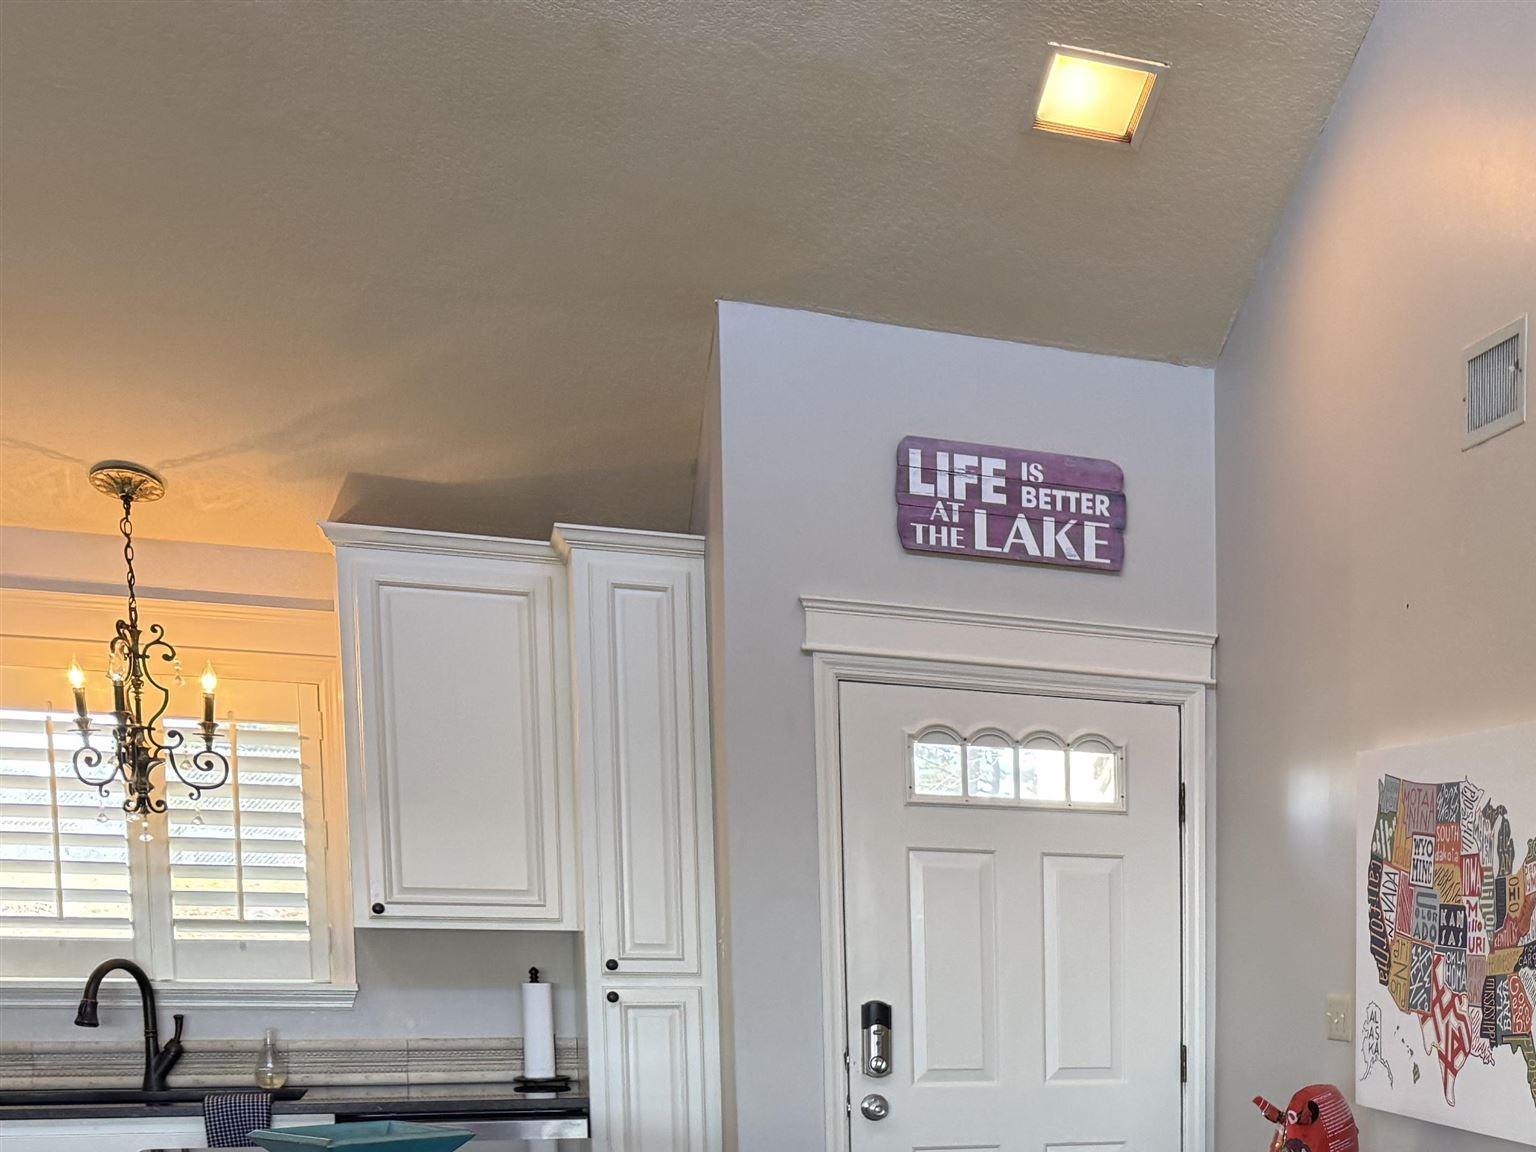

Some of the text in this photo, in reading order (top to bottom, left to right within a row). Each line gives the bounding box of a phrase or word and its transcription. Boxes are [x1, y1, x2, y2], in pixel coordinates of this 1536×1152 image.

[908, 448, 1007, 505] LIFE
[1021, 461, 1044, 483] IS
[930, 500, 964, 523] AT
[1021, 485, 1111, 517] BETTER
[910, 522, 965, 548] THE
[974, 508, 1111, 564] LAKE
[1436, 825, 1459, 842] SOUTH
[1413, 838, 1434, 857] WYO
[1411, 858, 1432, 885] MING
[1462, 858, 1481, 896] IOWA
[1508, 876, 1520, 913] OHIO
[1440, 909, 1465, 929] KAN
[1441, 928, 1463, 947] SAS
[1445, 951, 1466, 966] OKLA
[1445, 965, 1467, 992] HOMA
